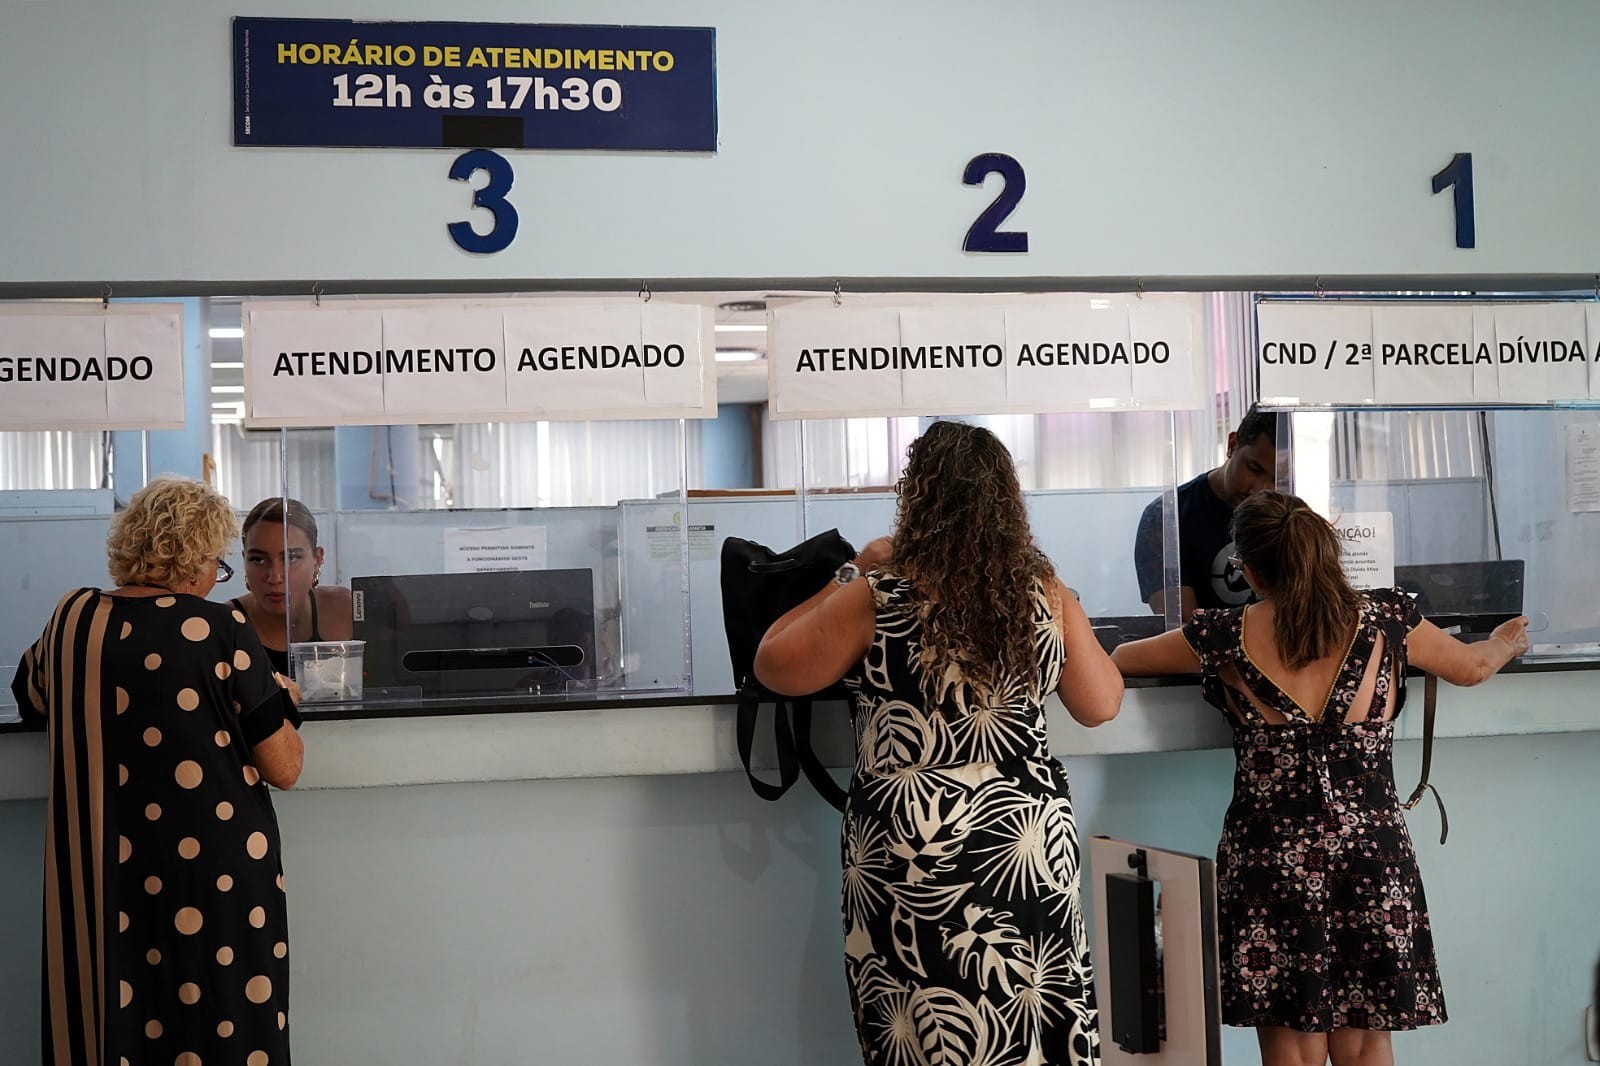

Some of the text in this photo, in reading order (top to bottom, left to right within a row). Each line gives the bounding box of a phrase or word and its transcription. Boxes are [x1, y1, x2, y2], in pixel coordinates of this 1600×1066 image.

[278, 39, 674, 72] HORÁRIO DE ATENDIMENTO
[333, 73, 622, 112] 12h às 17h30
[447, 148, 519, 254] 3
[962, 152, 1029, 253] 2
[1431, 152, 1475, 249] 1
[0, 355, 153, 382] GENDADO
[273, 344, 685, 376] ATENDIMENTO AGENDADO
[796, 341, 1170, 372] ATENDIMENTO AGENDADO
[1262, 342, 1317, 364] CND
[1324, 340, 1337, 369] /
[1345, 343, 1372, 365] 2ª
[1382, 342, 1493, 365] PARCELA
[1499, 336, 1586, 363] DÍVIDA
[1337, 525, 1376, 540] NÇÃO!
